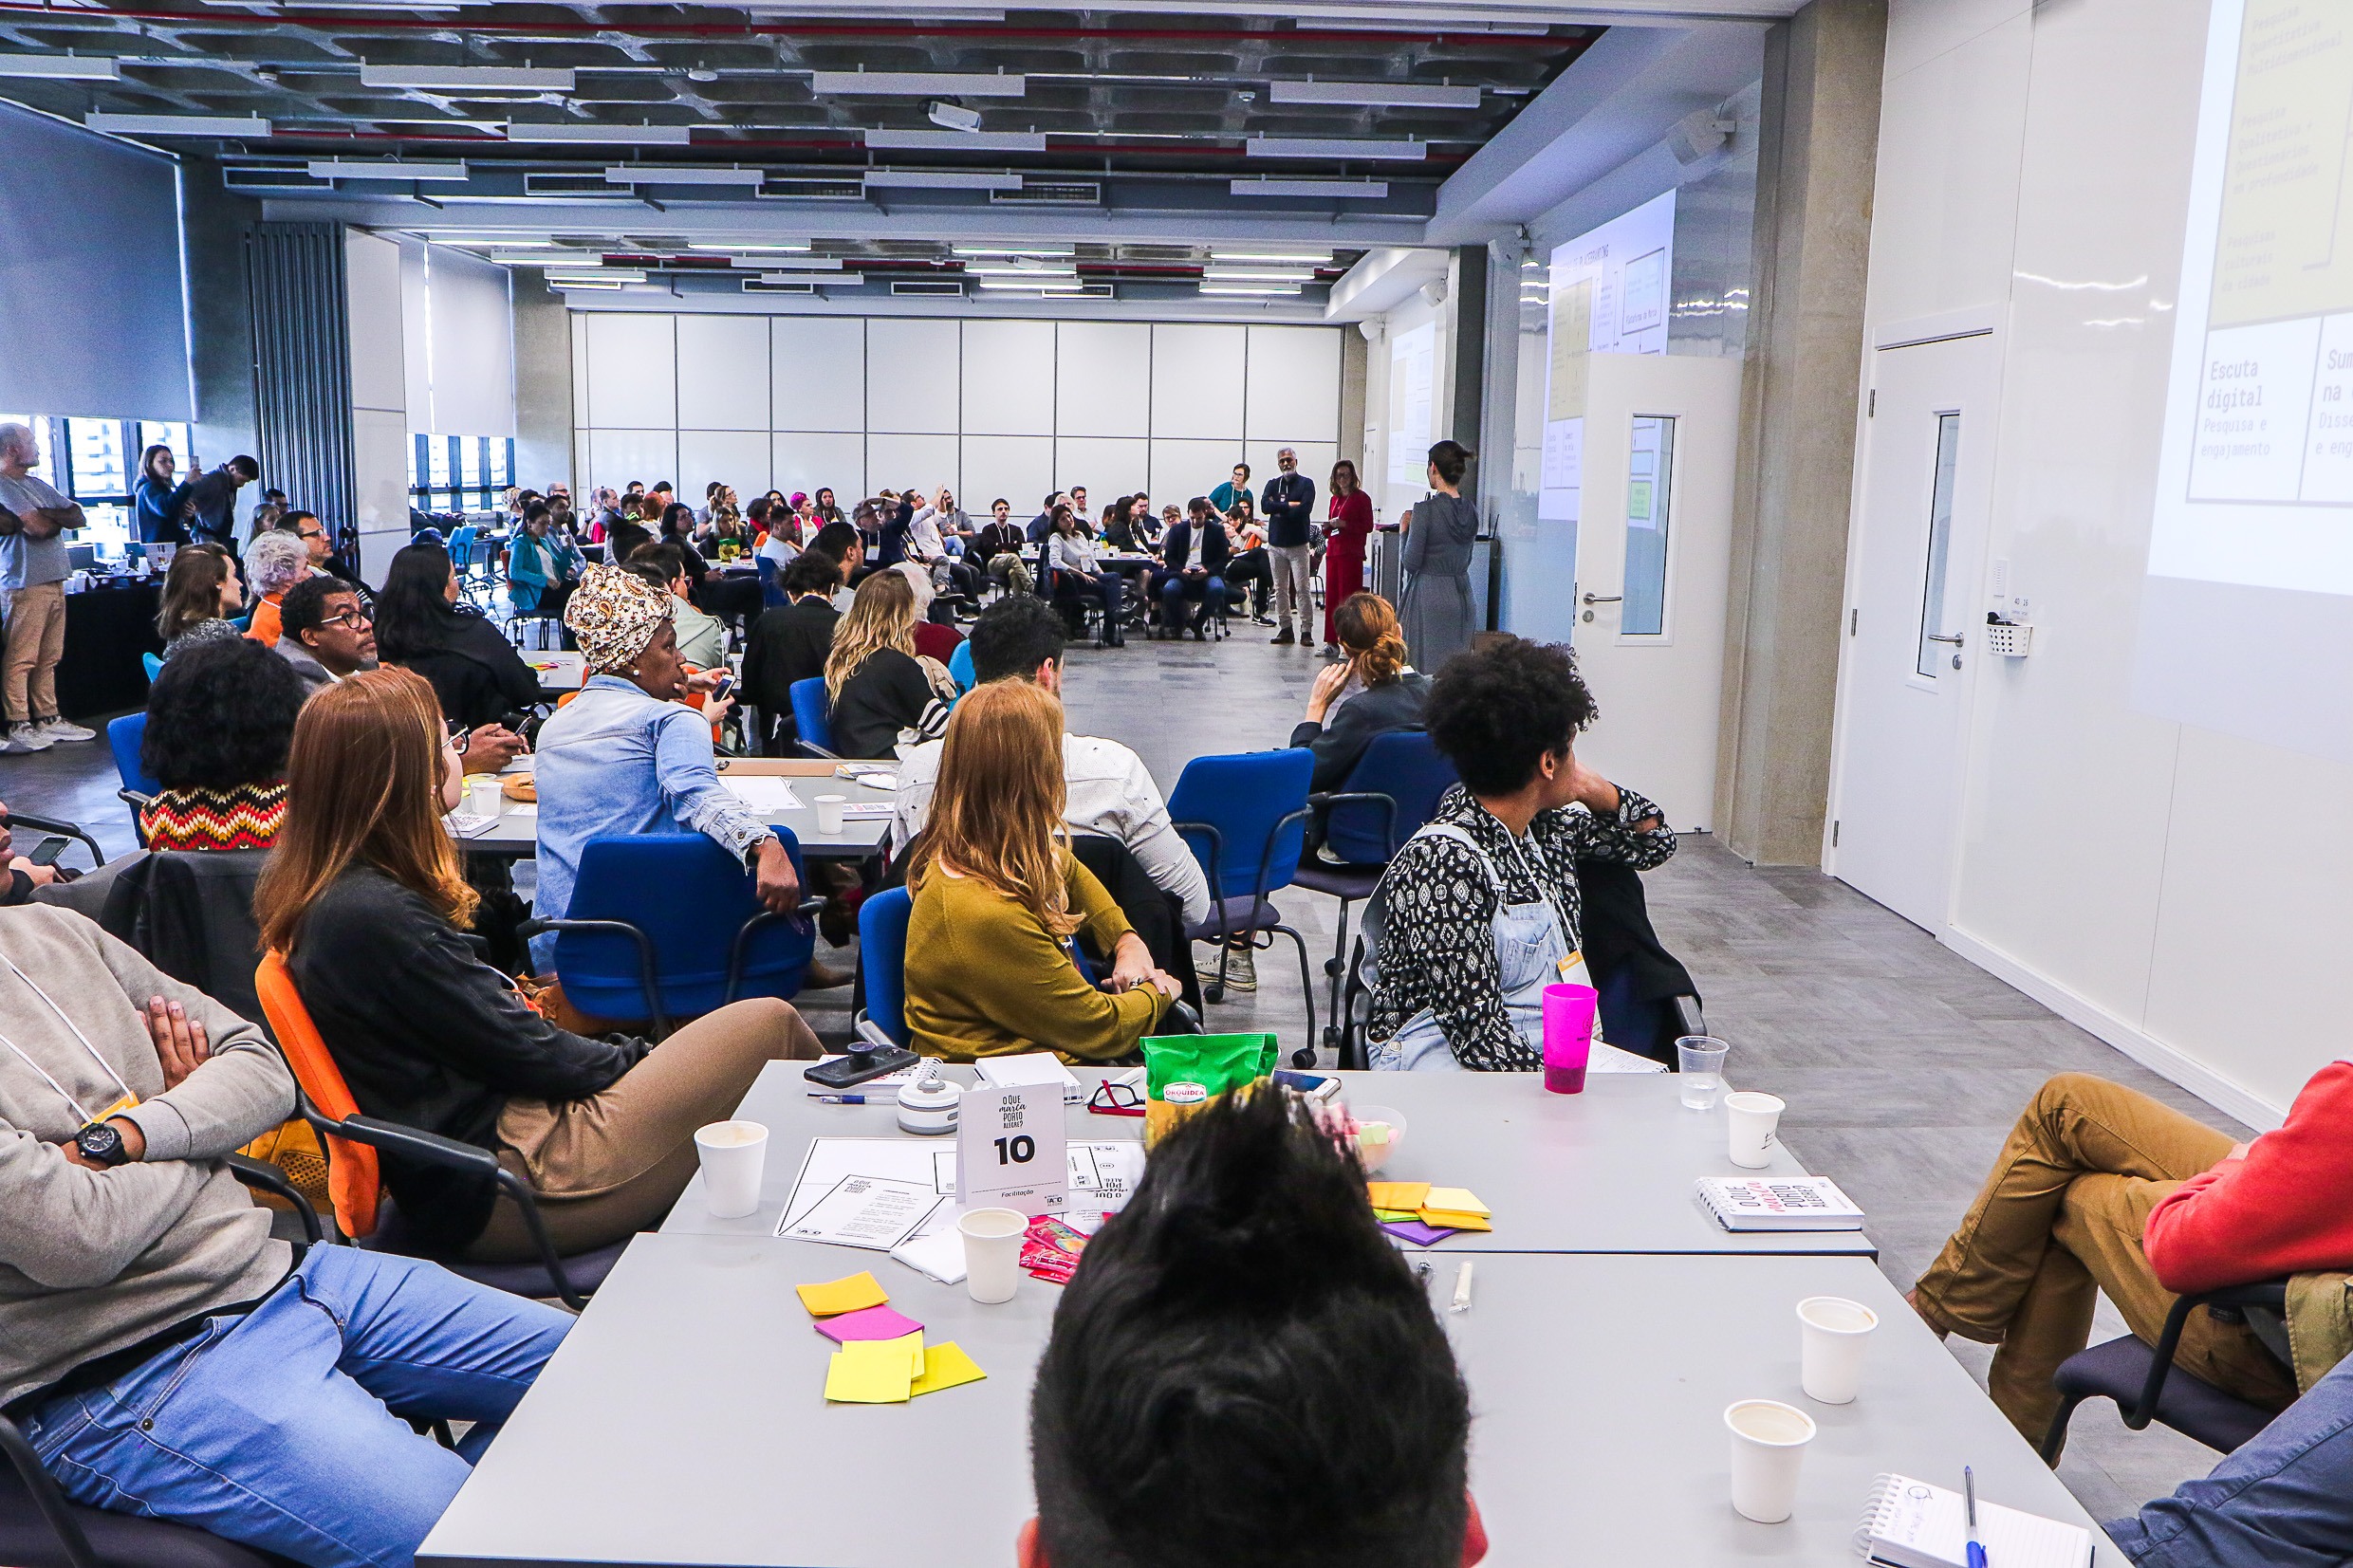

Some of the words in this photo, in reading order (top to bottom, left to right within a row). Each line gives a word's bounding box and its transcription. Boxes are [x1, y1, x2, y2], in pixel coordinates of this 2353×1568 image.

[2252, 6, 2300, 31] Pesquisa
[2240, 106, 2287, 127] Pesquisa
[2248, 162, 2320, 194] profundidade
[2210, 360, 2259, 381] Escuta
[2207, 385, 2263, 414] digital
[2323, 384, 2343, 402] na
[2203, 417, 2254, 435] Pesquisa
[2260, 418, 2269, 432] e
[2201, 440, 2271, 461] engajamento
[2315, 440, 2324, 455] e
[999, 1102, 1028, 1113] marca
[1008, 1095, 1021, 1105] QUE
[1003, 1111, 1024, 1123] PORTO
[1003, 1120, 1024, 1129] ALEGRE?
[993, 1134, 1036, 1166] 10
[1001, 1189, 1034, 1198] Facilitação
[1725, 1186, 1757, 1202] QUE
[1747, 1181, 1786, 1212] marca
[1769, 1185, 1806, 1208] PORTO
[1791, 1186, 1830, 1208] ALEGRE?
